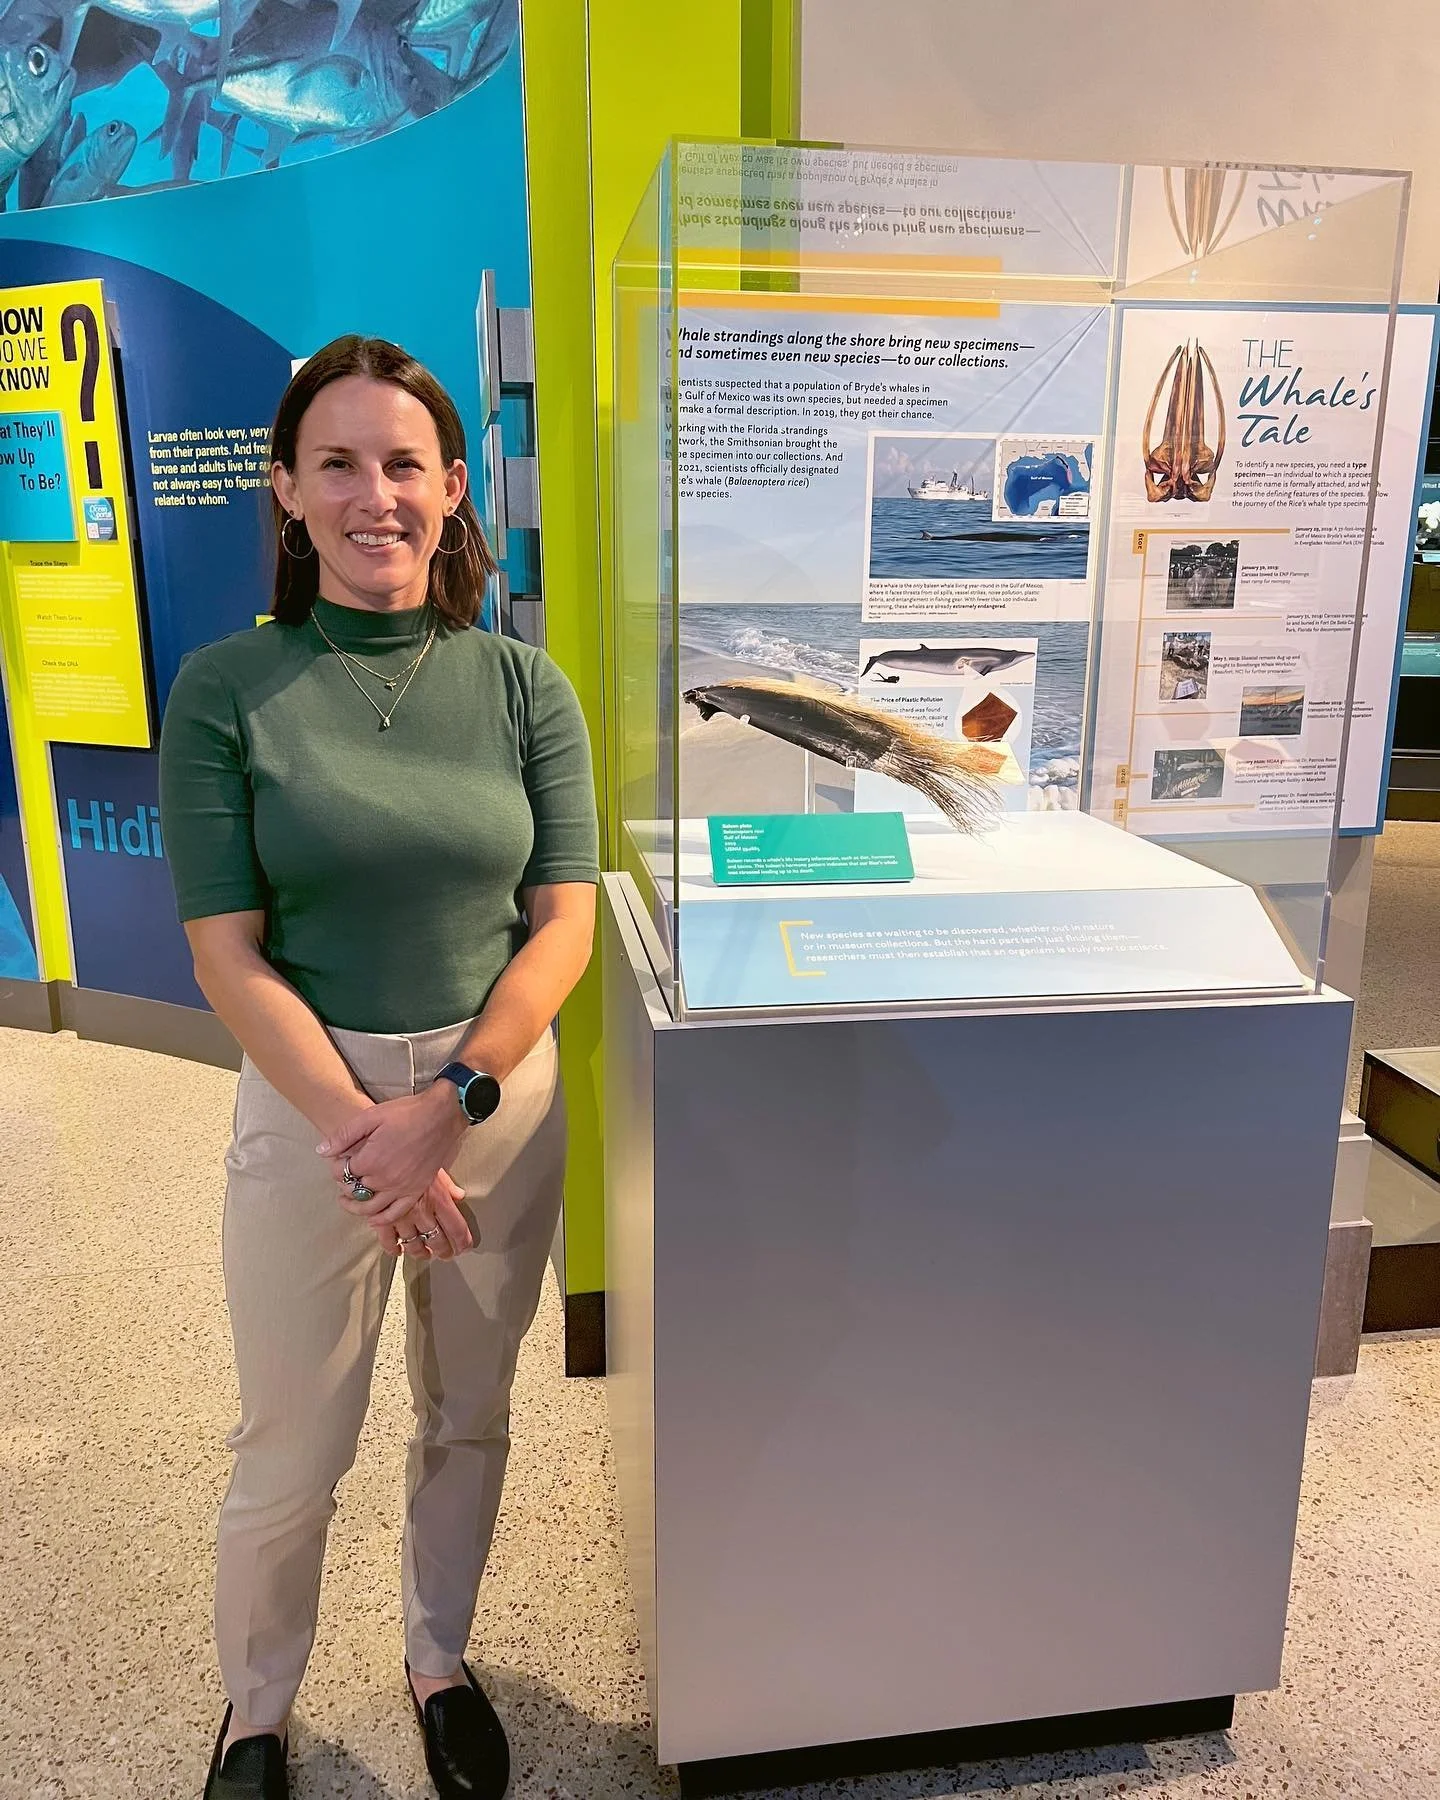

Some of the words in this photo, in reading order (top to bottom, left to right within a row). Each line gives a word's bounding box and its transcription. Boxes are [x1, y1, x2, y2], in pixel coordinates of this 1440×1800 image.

[712, 329, 784, 347] strandings
[786, 331, 823, 348] along
[824, 332, 847, 345] the
[848, 332, 885, 347] shore
[887, 334, 922, 352] bring
[923, 340, 951, 350] new
[952, 337, 1035, 352] specimens—
[0, 339, 13, 363] O
[17, 337, 48, 361] WE
[694, 347, 768, 360] sometimes
[770, 350, 800, 361] even
[803, 351, 831, 362] new
[832, 351, 911, 366] species—to
[913, 352, 936, 364] our
[937, 351, 1008, 368] collections.
[1242, 339, 1294, 368] THE
[666, 377, 712, 388] Sientists
[713, 379, 761, 392] suspected
[763, 379, 782, 389] that
[784, 381, 790, 389] a
[791, 380, 840, 392] population
[841, 380, 852, 391] of
[853, 381, 886, 394] Bryde's
[888, 383, 920, 392] whales
[921, 383, 930, 392] in
[1239, 367, 1377, 410] Whale's
[61, 303, 102, 489] ?
[683, 389, 704, 400] Gulf
[705, 390, 716, 400] of
[717, 391, 750, 401] Mexico
[751, 394, 770, 402] was
[772, 392, 784, 402] its
[807, 394, 844, 405] species,
[845, 394, 861, 404] but
[863, 395, 896, 405] needed
[905, 397, 948, 407] specimen
[678, 403, 704, 413] make
[713, 403, 744, 414] formal
[745, 405, 800, 416] description.
[801, 406, 810, 416] In
[812, 408, 837, 418] 2019,
[839, 407, 860, 420] they
[860, 409, 876, 420] got
[877, 408, 899, 418] their
[899, 409, 934, 418] chance.
[0, 426, 12, 439] at
[13, 420, 55, 441] They'll
[147, 430, 178, 442] Larvae
[178, 429, 203, 441] often
[204, 427, 224, 440] look
[224, 428, 247, 441] very,
[249, 427, 269, 440] very
[706, 423, 728, 432] with
[729, 423, 745, 433] the
[746, 424, 778, 434] Florida
[779, 425, 828, 437] strandings
[1237, 413, 1312, 448] Tale
[148, 446, 171, 458] from
[172, 445, 193, 457] their
[194, 444, 231, 459] parents.
[232, 443, 252, 455] And
[252, 442, 272, 456] fre
[665, 435, 707, 447] ntwork,
[709, 436, 724, 446] the
[726, 436, 783, 447] Smithsonian
[784, 438, 820, 450] brought
[822, 438, 838, 448] the
[0, 453, 15, 465] ow
[18, 447, 35, 468] Up
[689, 450, 733, 460] specimen
[735, 450, 753, 459] into
[754, 452, 771, 460] our
[772, 450, 823, 461] collections.
[824, 452, 843, 461] And
[150, 462, 178, 474] larvae
[179, 461, 197, 473] and
[197, 460, 226, 472] adults
[226, 460, 243, 471] live
[243, 459, 257, 471] far
[678, 463, 702, 472] 2021,
[703, 463, 748, 472] scientists
[749, 462, 788, 476] officially
[789, 464, 839, 476] designated
[1235, 460, 1243, 468] To
[1243, 459, 1269, 470] identify
[1315, 462, 1328, 470] you
[1329, 460, 1346, 468] need
[1351, 461, 1367, 470] type
[19, 474, 35, 490] To
[38, 472, 61, 490] Be?
[152, 478, 168, 490] not
[169, 477, 200, 492] always
[201, 479, 222, 491] easy
[223, 477, 234, 488] to
[234, 475, 262, 490] figure
[694, 475, 722, 485] whale
[723, 475, 785, 487] (Balaenoptera
[786, 477, 809, 488] ricei)
[1234, 470, 1282, 479] specimen—an
[1282, 470, 1314, 478] individual
[1321, 470, 1342, 478] which
[1347, 472, 1372, 480] species
[153, 493, 185, 506] related
[185, 494, 196, 505] to
[197, 492, 229, 505] whom.
[695, 489, 732, 499] species.
[1137, 533, 1145, 550] 2019
[67, 798, 163, 858] Hidi
[800, 932, 824, 940] New
[826, 931, 864, 940] species
[884, 928, 922, 939] waiting
[923, 928, 933, 936] to
[935, 927, 949, 936] be
[951, 925, 1008, 936] discovered,
[1009, 923, 1049, 933] whether
[1052, 924, 1070, 932] out
[1071, 923, 1080, 931] in
[1083, 923, 1115, 931] nature
